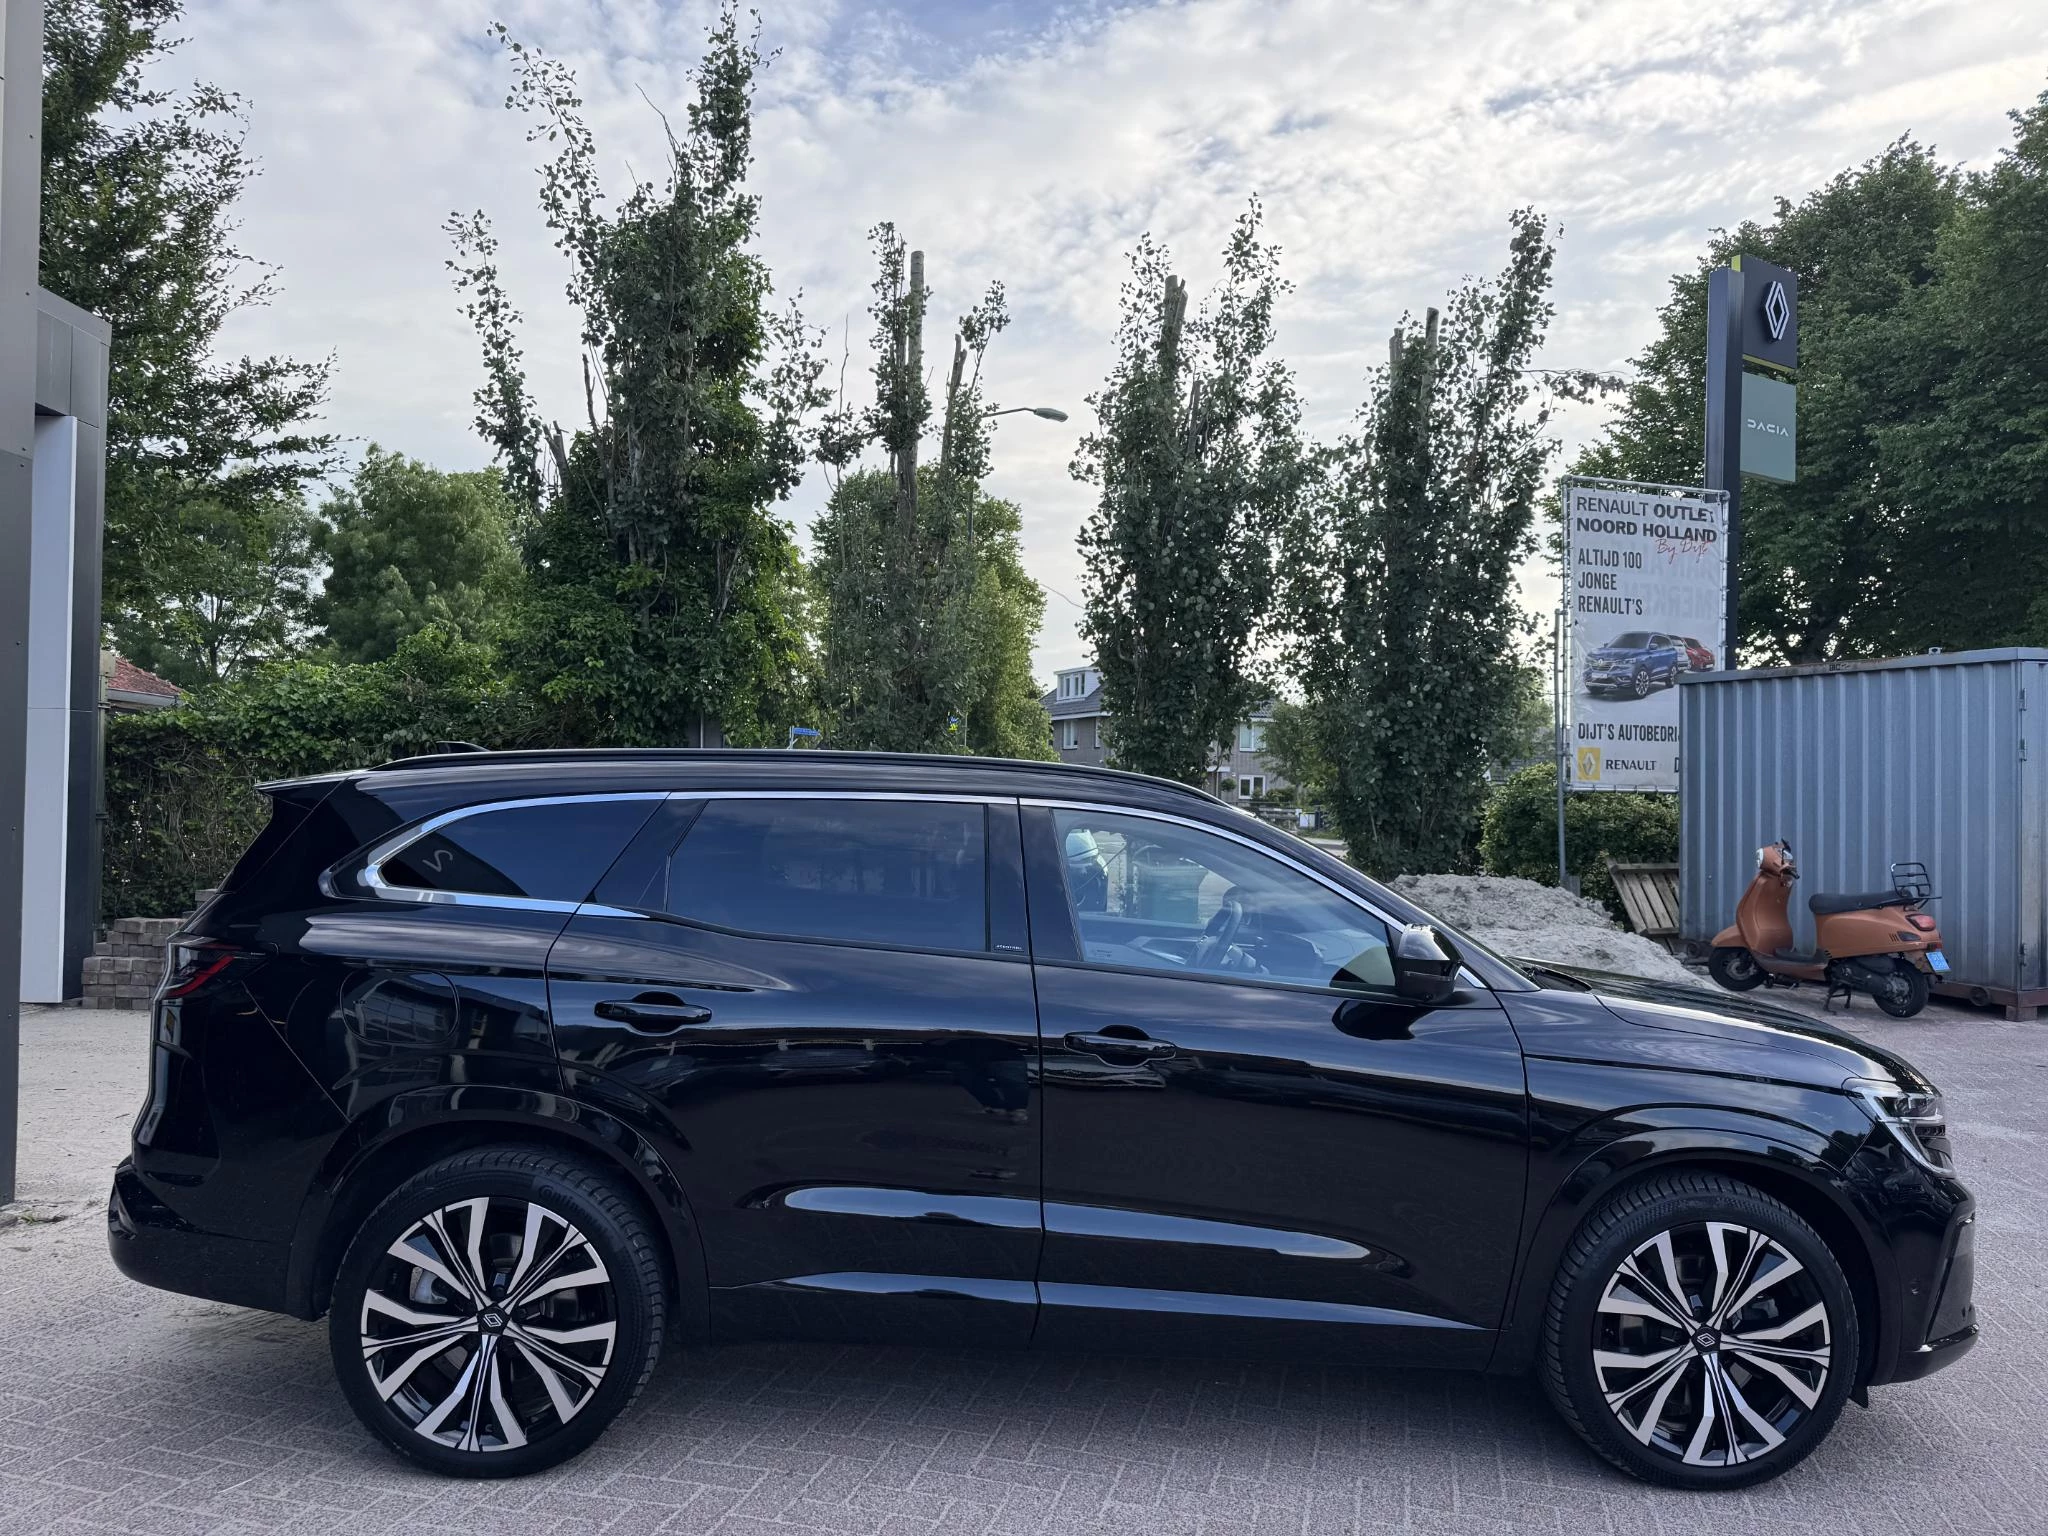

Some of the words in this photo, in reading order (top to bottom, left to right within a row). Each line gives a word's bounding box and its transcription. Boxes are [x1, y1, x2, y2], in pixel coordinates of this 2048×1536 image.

[1747, 418, 1789, 437] DACIA
[1576, 496, 1649, 517] RENAULT
[1653, 503, 1715, 523] OUTLET
[1576, 517, 1638, 536] NOORD
[1643, 523, 1717, 543] HOLLAND
[1578, 548, 1619, 567] ALTIJD
[1622, 551, 1642, 569] 100
[1578, 571, 1617, 590] JONGE
[1578, 595, 1643, 615] RENAULT'S
[1578, 723, 1614, 740] DIJT'S
[1605, 759, 1657, 771] RENAULT
